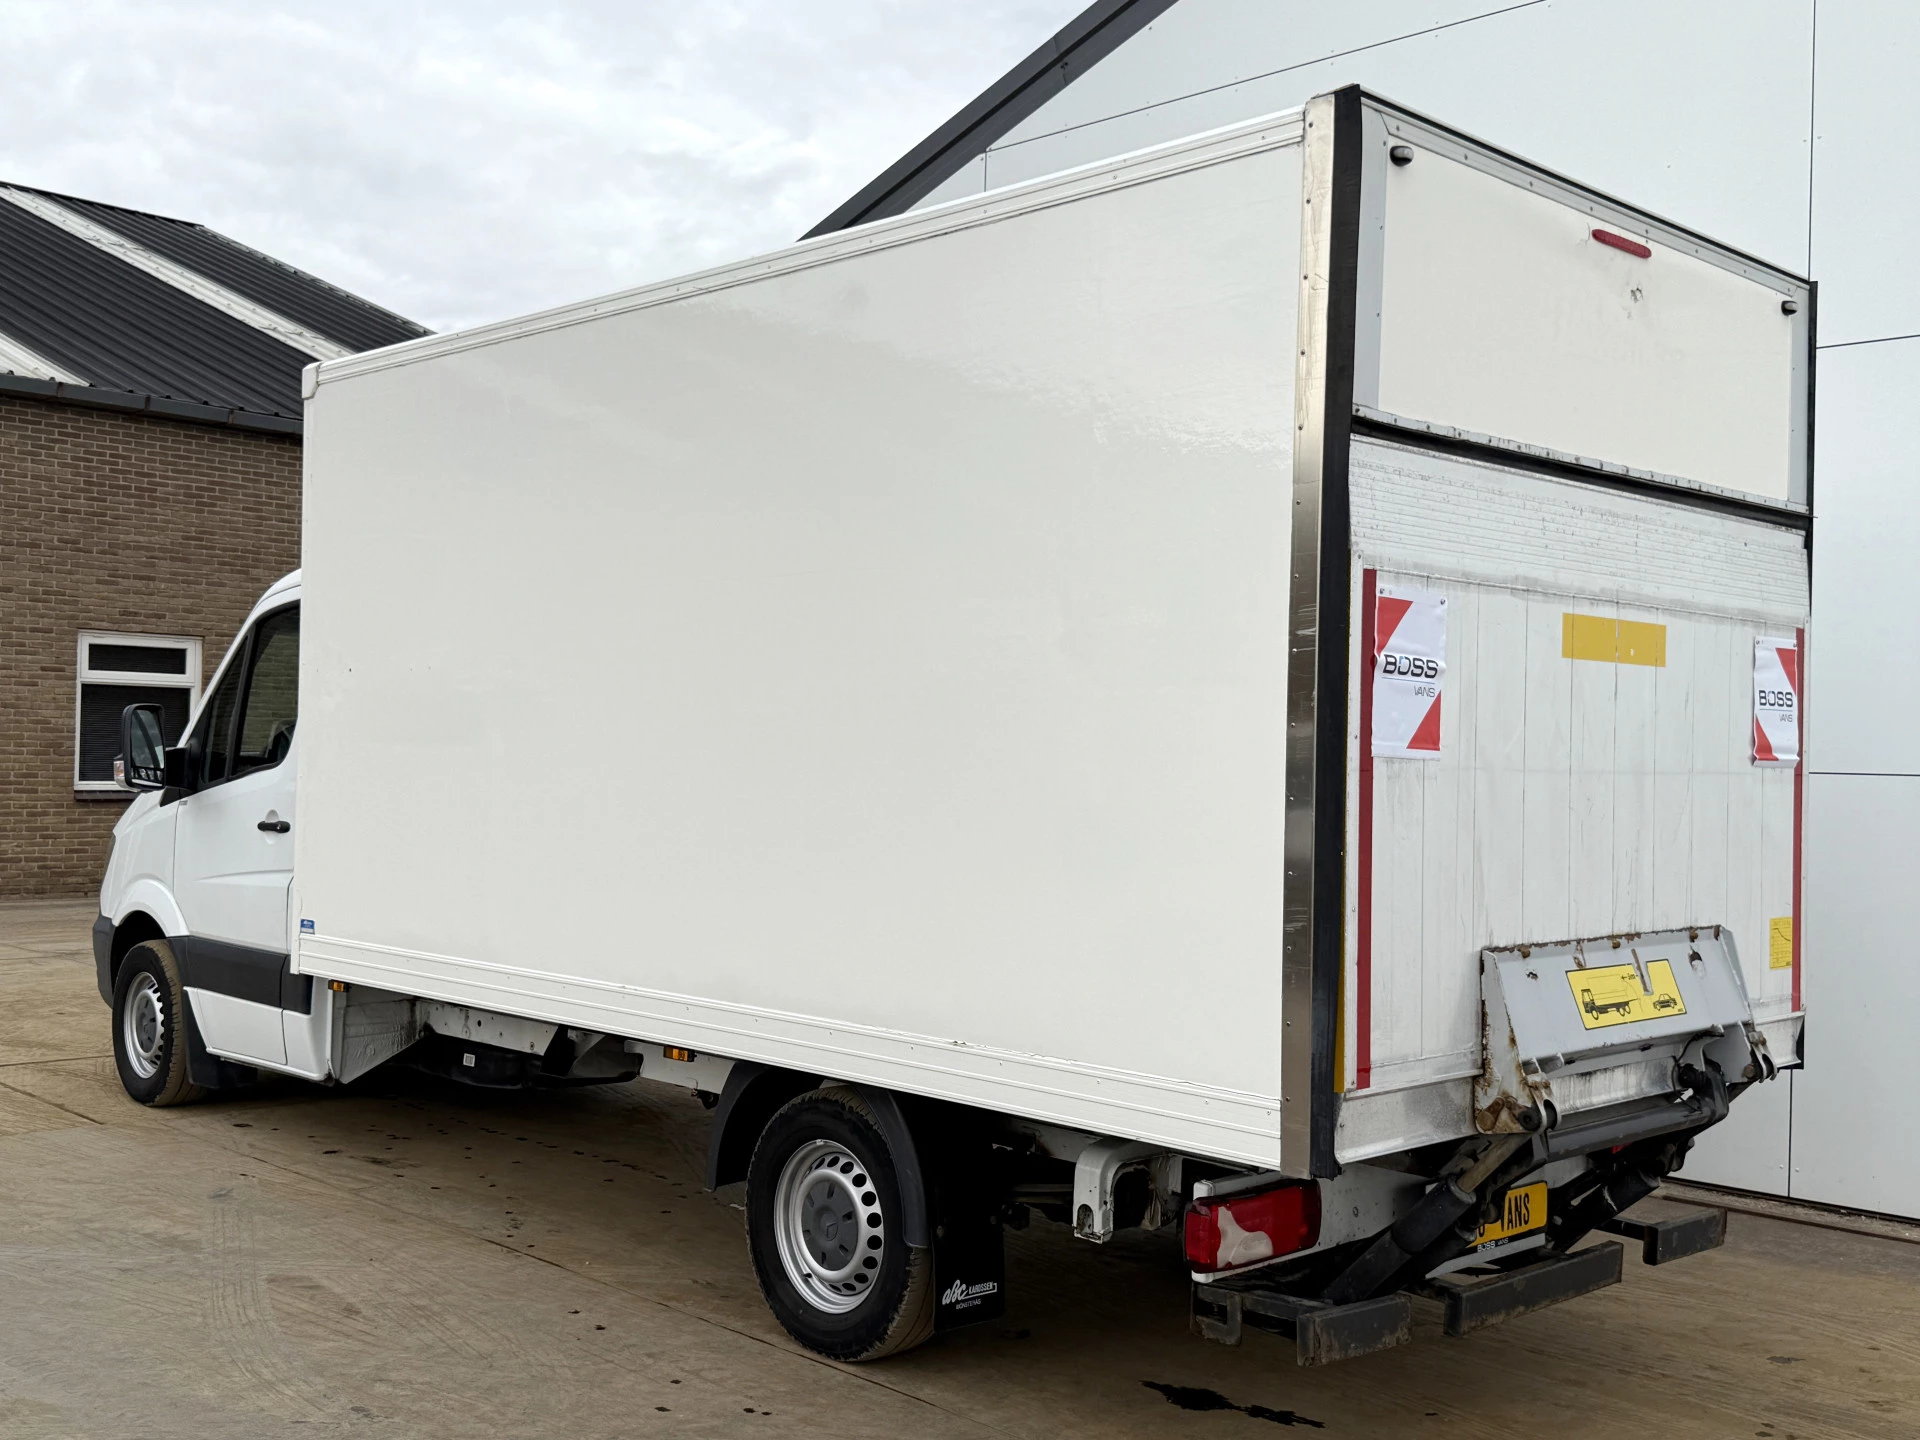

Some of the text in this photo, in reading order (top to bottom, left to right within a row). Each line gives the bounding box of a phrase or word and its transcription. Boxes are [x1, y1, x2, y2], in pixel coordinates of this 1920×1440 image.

[1382, 654, 1439, 679] BOSS
[1414, 686, 1435, 697] VANS
[1758, 690, 1794, 707] BOSS
[1779, 714, 1793, 722] VANS
[968, 1281, 994, 1295] KAROSSEN
